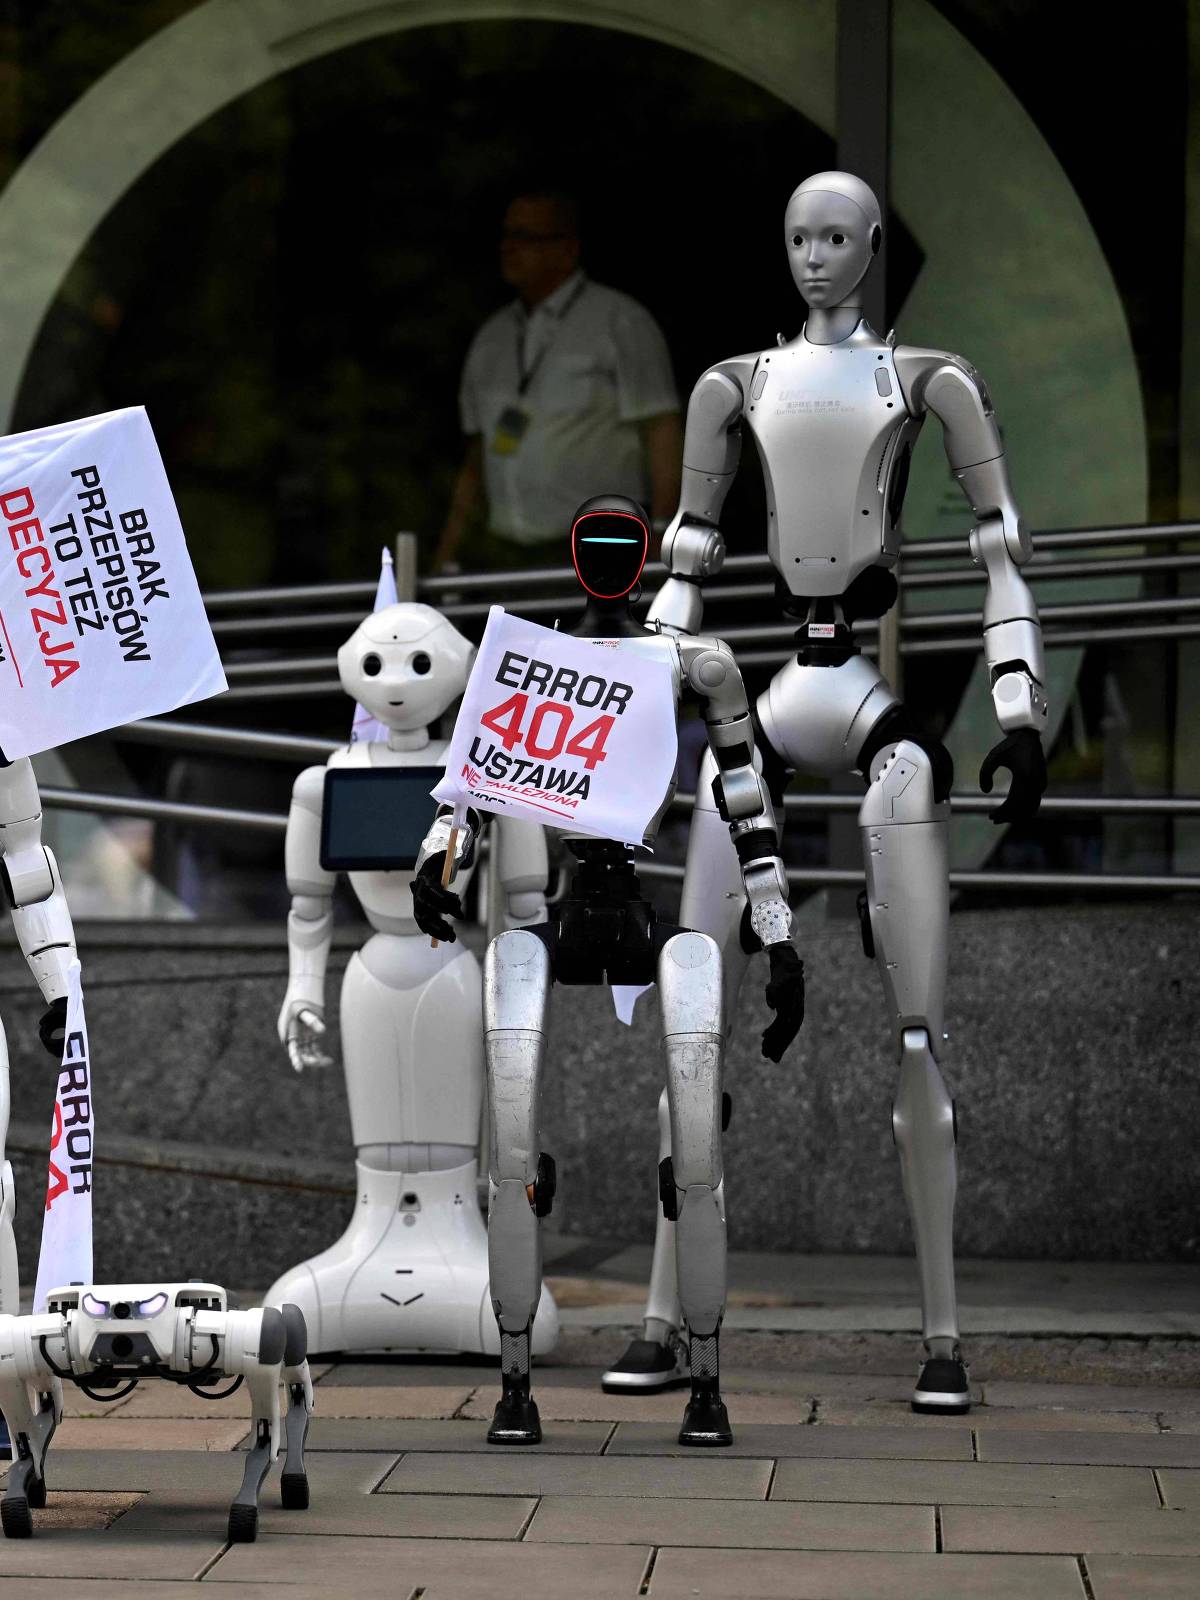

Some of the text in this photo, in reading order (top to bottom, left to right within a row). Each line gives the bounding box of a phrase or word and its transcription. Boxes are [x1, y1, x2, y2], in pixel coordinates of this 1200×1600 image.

[49, 512, 109, 636] TO TEŻ
[70, 464, 151, 662] PRZEPISÓW
[118, 508, 170, 605] BRAK
[480, 692, 617, 770] 404
[494, 650, 634, 715] ERROR
[468, 736, 591, 800] USTAWA
[60, 1031, 92, 1195] ERROR
